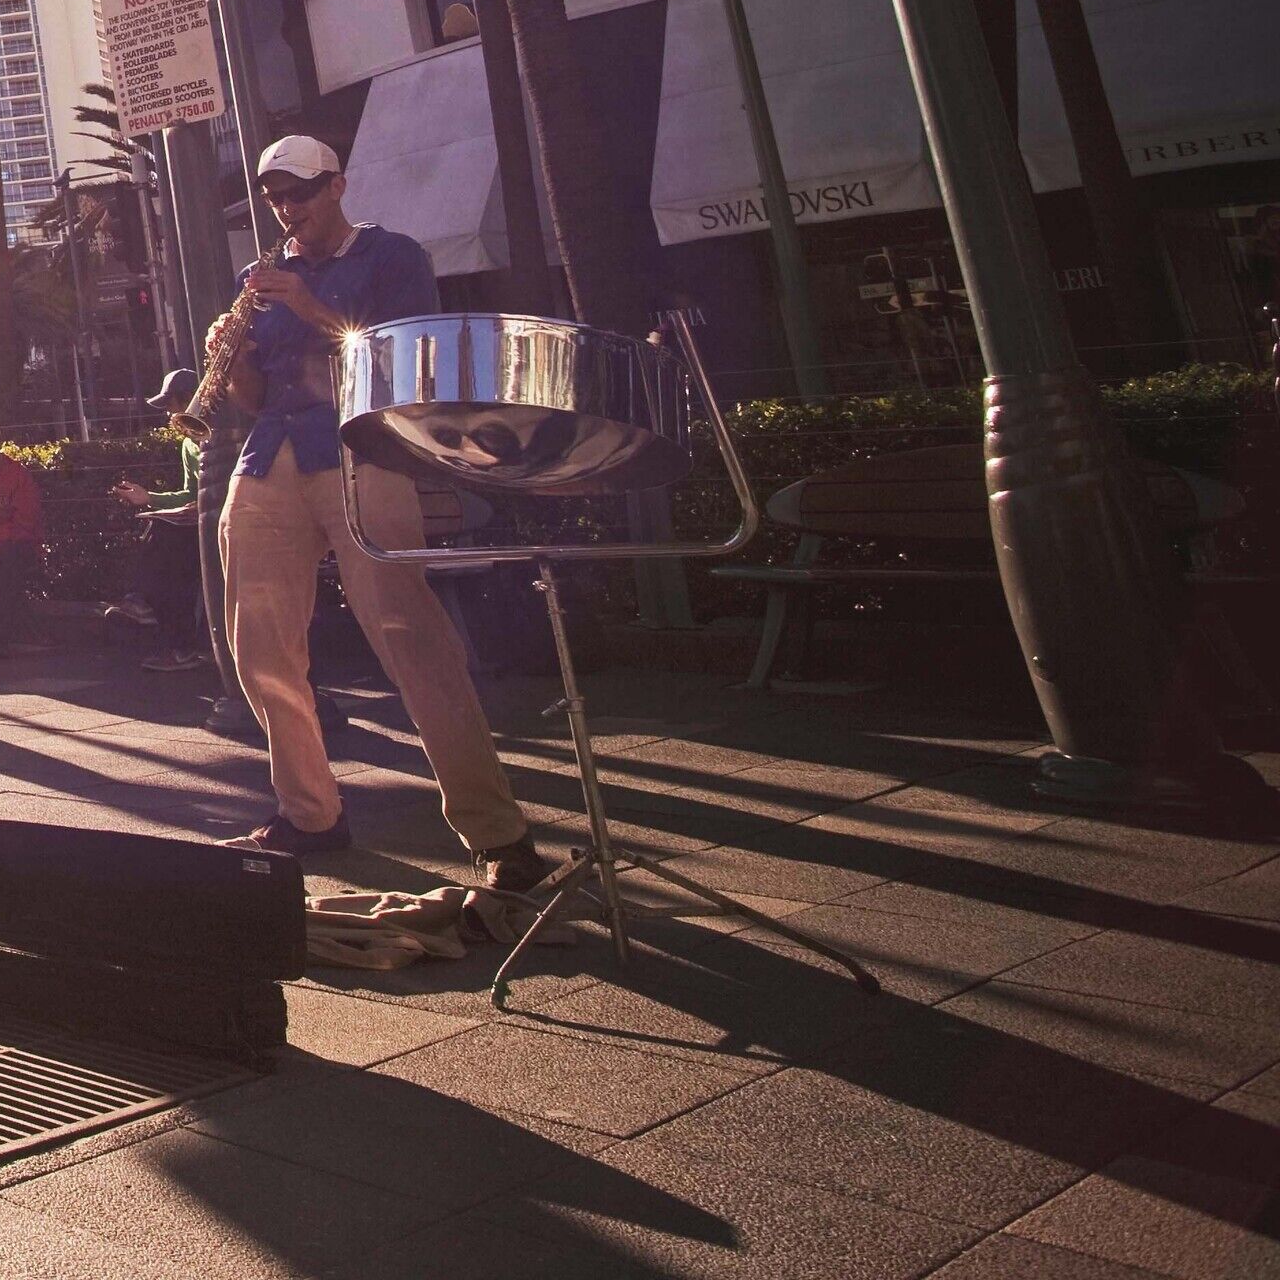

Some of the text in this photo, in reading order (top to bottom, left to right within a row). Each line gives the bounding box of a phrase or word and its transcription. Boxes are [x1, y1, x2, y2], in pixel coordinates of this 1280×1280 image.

[106, 0, 207, 36] AND CONVEYANCES ARE PROHIBITED
[108, 16, 120, 25] THE
[120, 5, 155, 22] FOLLOWING
[156, 1, 169, 11] TOY
[109, 18, 209, 53] FOOTWAY WITHIN THE CBD AREA
[114, 11, 200, 43] FROM BEING RIDDEN ON THE
[122, 39, 175, 61] SKATEBOARDS
[123, 48, 177, 69] ROLLERBLADES
[124, 62, 160, 78] PEDICABS
[126, 71, 164, 87] SCOOTERS
[127, 82, 160, 97] BICYCLES
[129, 79, 208, 106] MOTORISED BICYCLES
[131, 87, 215, 115] MOTORISED SCOOTERS
[128, 100, 215, 131] PENALTY $750.00
